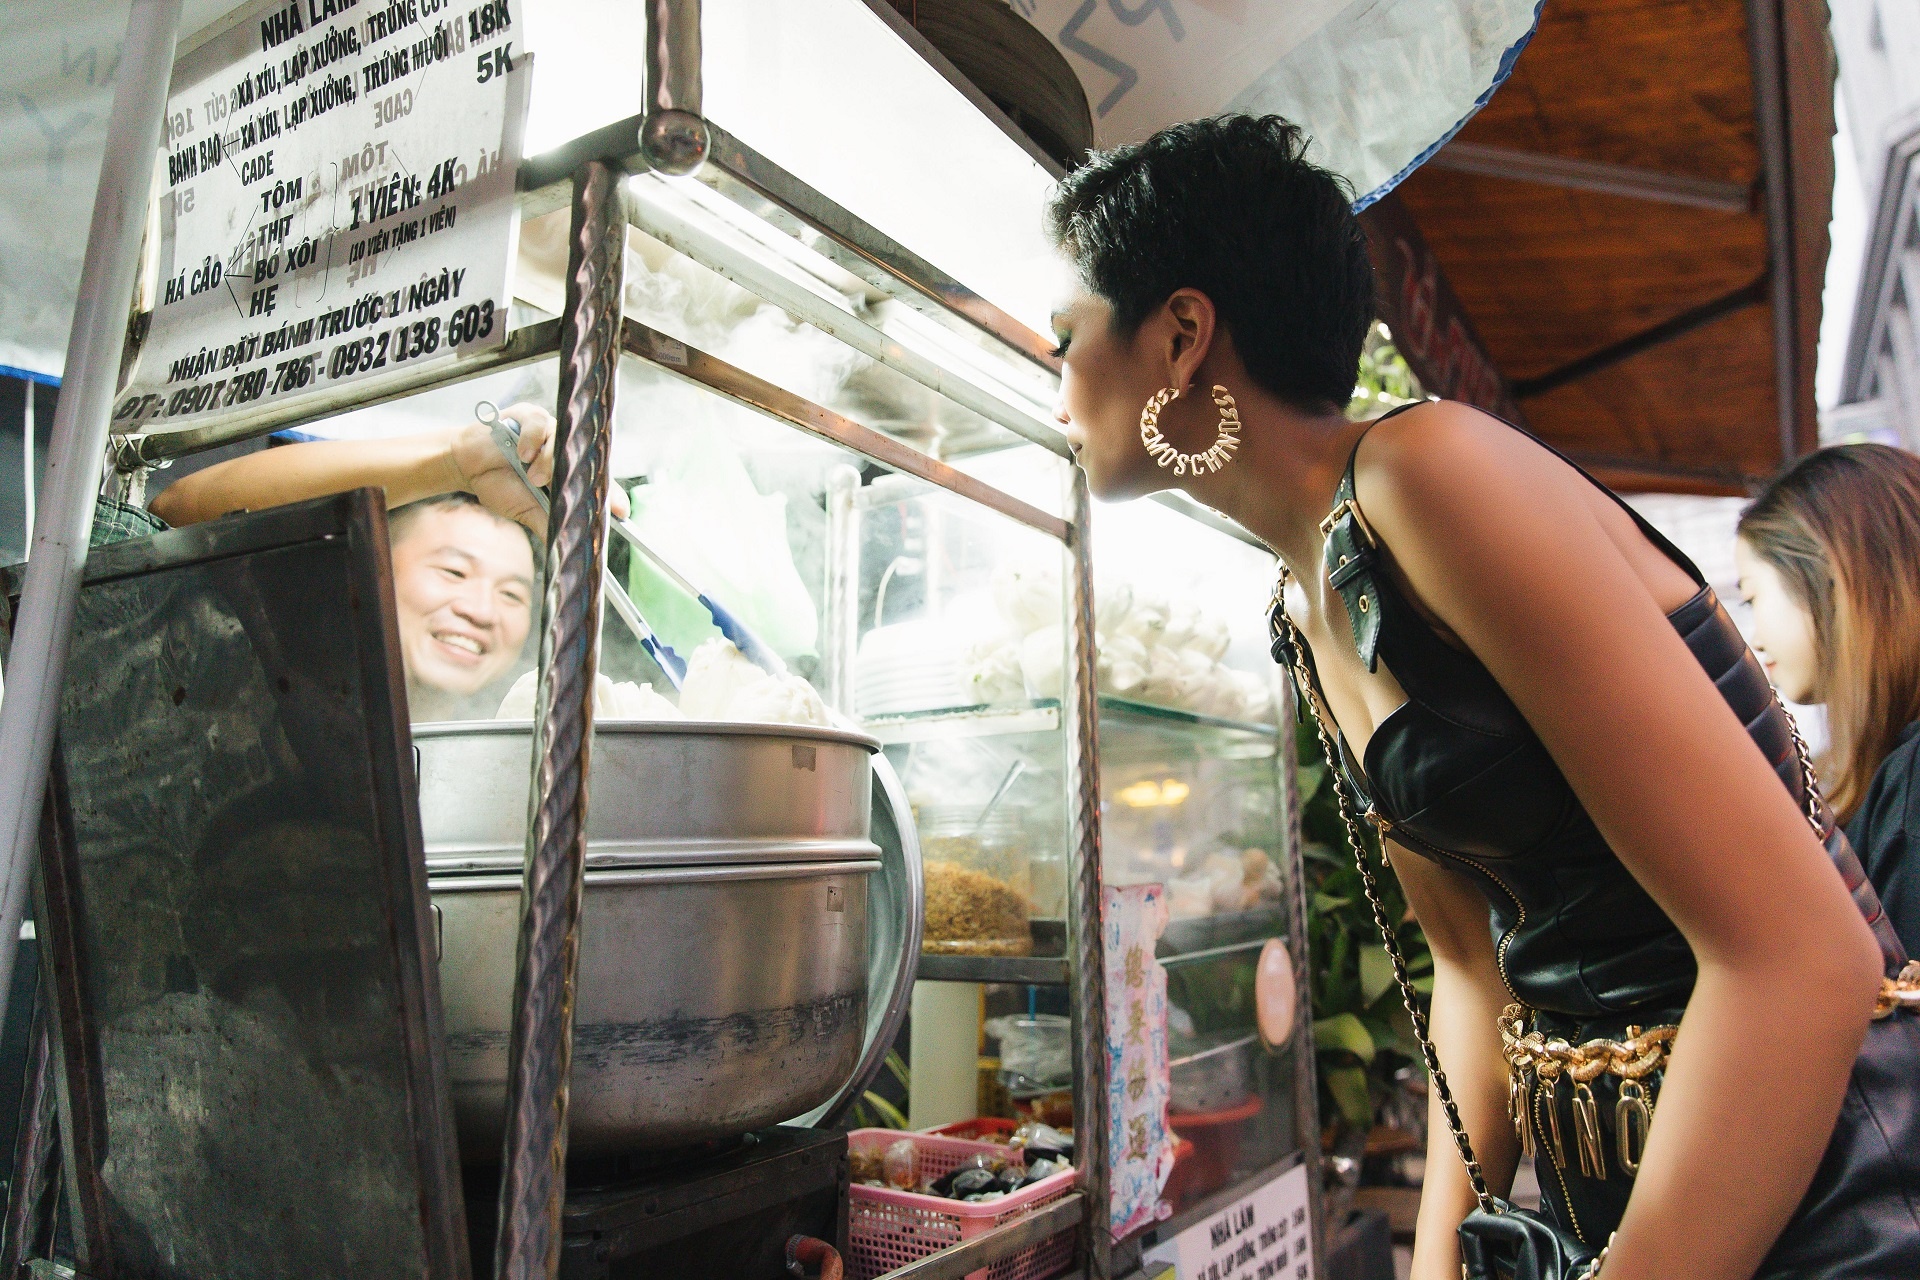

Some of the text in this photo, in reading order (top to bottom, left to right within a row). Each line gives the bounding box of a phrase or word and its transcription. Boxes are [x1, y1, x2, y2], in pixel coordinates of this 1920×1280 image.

[237, 72, 255, 109] XÁ
[240, 114, 256, 150] XÁ
[363, 49, 409, 93] TRỨNG
[411, 19, 448, 71] MUỐI
[468, 0, 512, 43] 18K
[241, 41, 514, 187] CADE 5K
[169, 133, 220, 187] BÁNH BAO
[260, 177, 303, 213] TÔM
[350, 156, 459, 231] 1 VIÊN: 4K
[258, 213, 294, 246] THỊT
[349, 240, 365, 265] (10
[367, 229, 390, 257] VIÊN
[420, 217, 427, 238] 1
[429, 204, 457, 235] VIÊN)
[164, 255, 222, 306] HÁ CẢO
[254, 236, 319, 285] BÓ XÔI
[169, 267, 467, 383] NHẬN ĐẶT BÁNH TRƯỚC 1 NGÀY
[249, 284, 279, 318] HẸ
[167, 379, 227, 417] 0907
[331, 332, 390, 380] 0932
[396, 316, 441, 363] 138
[448, 299, 495, 348] 603
[1144, 420, 1242, 477] MOSCHINO
